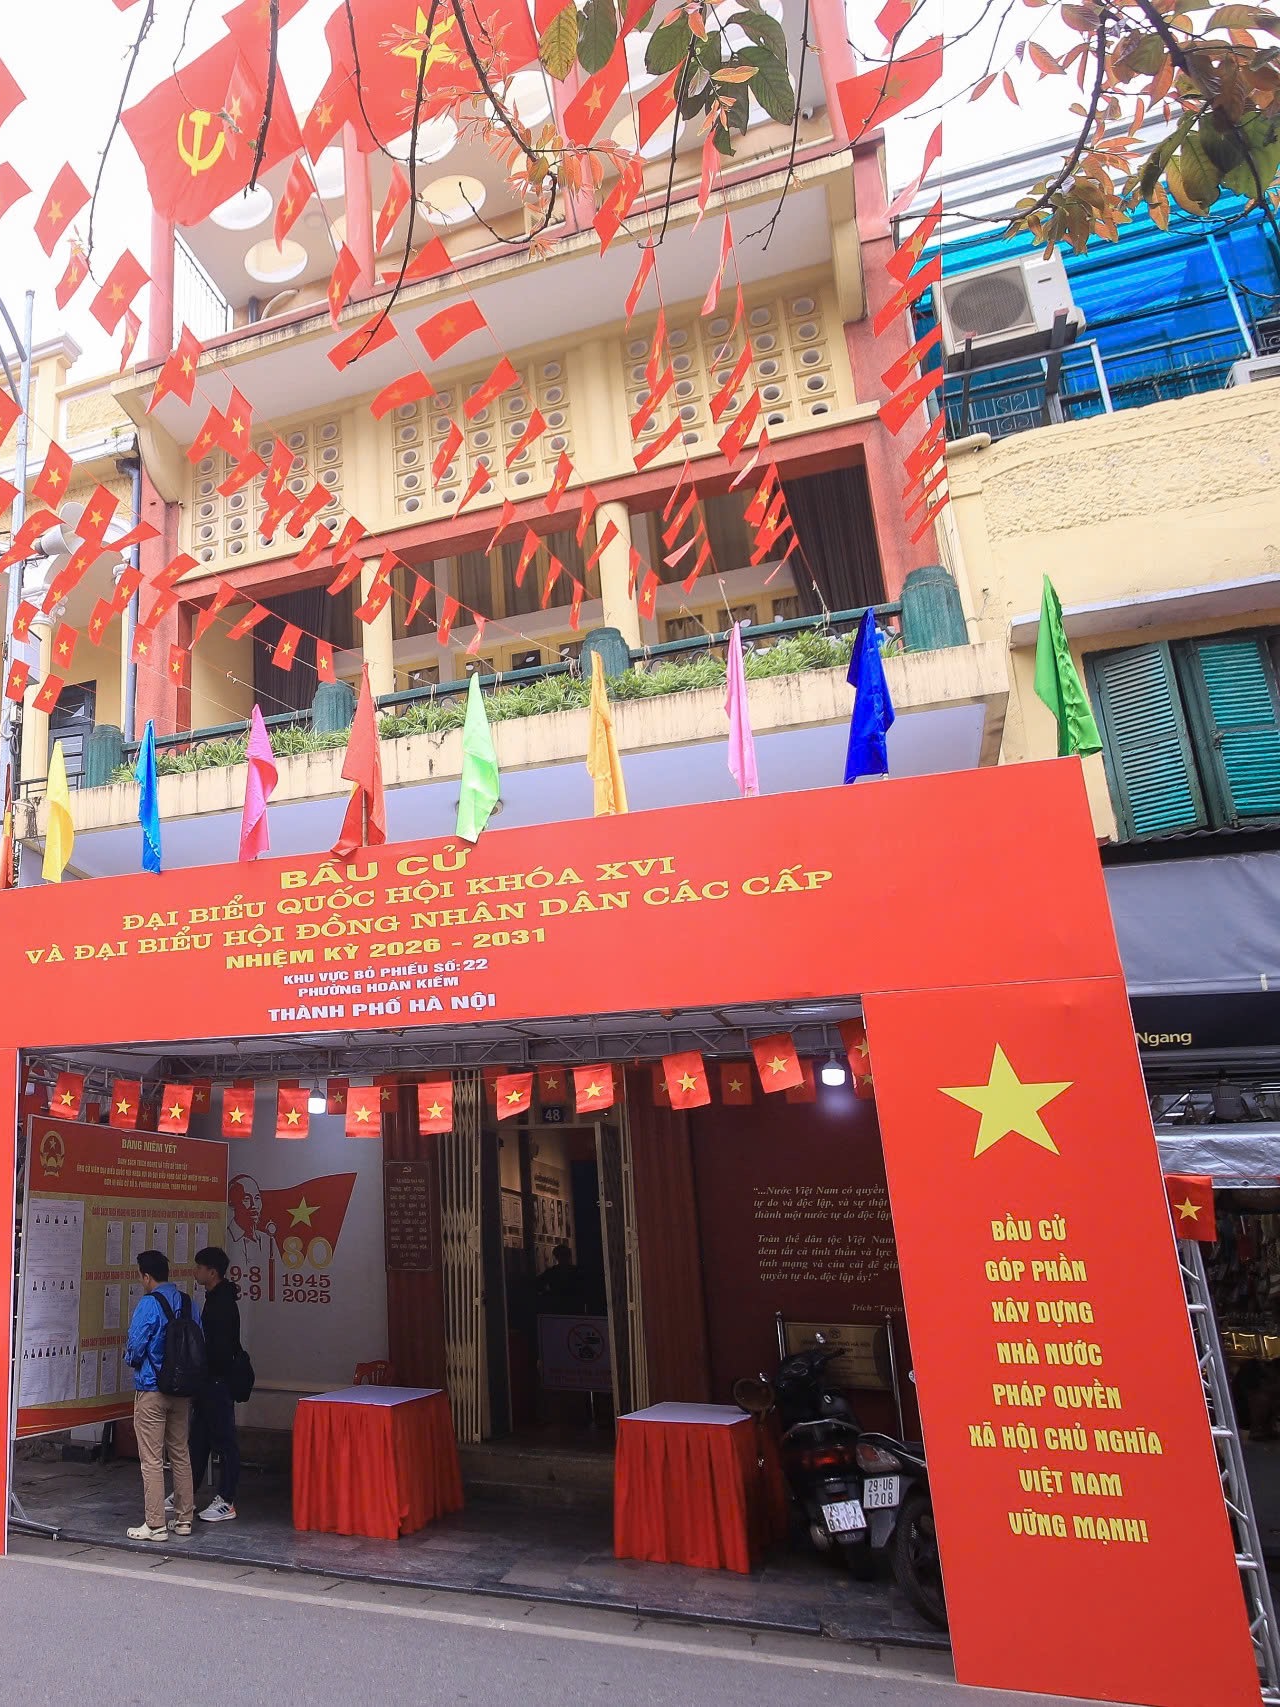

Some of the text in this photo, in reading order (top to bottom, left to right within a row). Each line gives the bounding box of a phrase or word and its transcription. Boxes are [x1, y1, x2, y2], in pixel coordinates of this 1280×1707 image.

[280, 844, 472, 891] BẦU CỬ
[122, 856, 676, 932] ĐẠI BIỂU QUỐC HỘI KHÓA XVI
[24, 864, 833, 964] VÀ ĐẠI BIỂU HỘI ĐỒNG NHÂN DÂN CÁC CẤP
[226, 927, 545, 970] NHIỆM KỲ 2026 2031
[283, 973, 315, 985] KHU
[318, 970, 350, 984] VỰC
[353, 965, 376, 980] BỎ
[380, 961, 429, 978] PHIẾU
[298, 974, 459, 998] PHƯỜNG HOÀN KIẾM
[267, 991, 496, 1022] THÀNH PHỐ HÀ NỘI
[1135, 1031, 1192, 1047] Ngang
[545, 1109, 561, 1121] 48
[991, 1212, 1066, 1241] BẦU CỬ
[230, 1265, 262, 1283] 9-8
[282, 1273, 331, 1288] 1945
[985, 1252, 1087, 1282] GÓP PHẦN
[282, 1289, 331, 1304] 2025
[991, 1297, 1094, 1328] XÂY DỰNG
[996, 1338, 1103, 1366] NHÀ NƯỚC
[992, 1378, 1122, 1409] PHÁP QUYỀN
[968, 1421, 1163, 1455] XÃ HỘI CHỦ NGHĨA
[868, 1478, 894, 1493] 29-U6
[1018, 1466, 1123, 1498] VIỆT NAM
[869, 1491, 893, 1507] 1208
[1008, 1508, 1149, 1545] VỮNG MẠNH!
